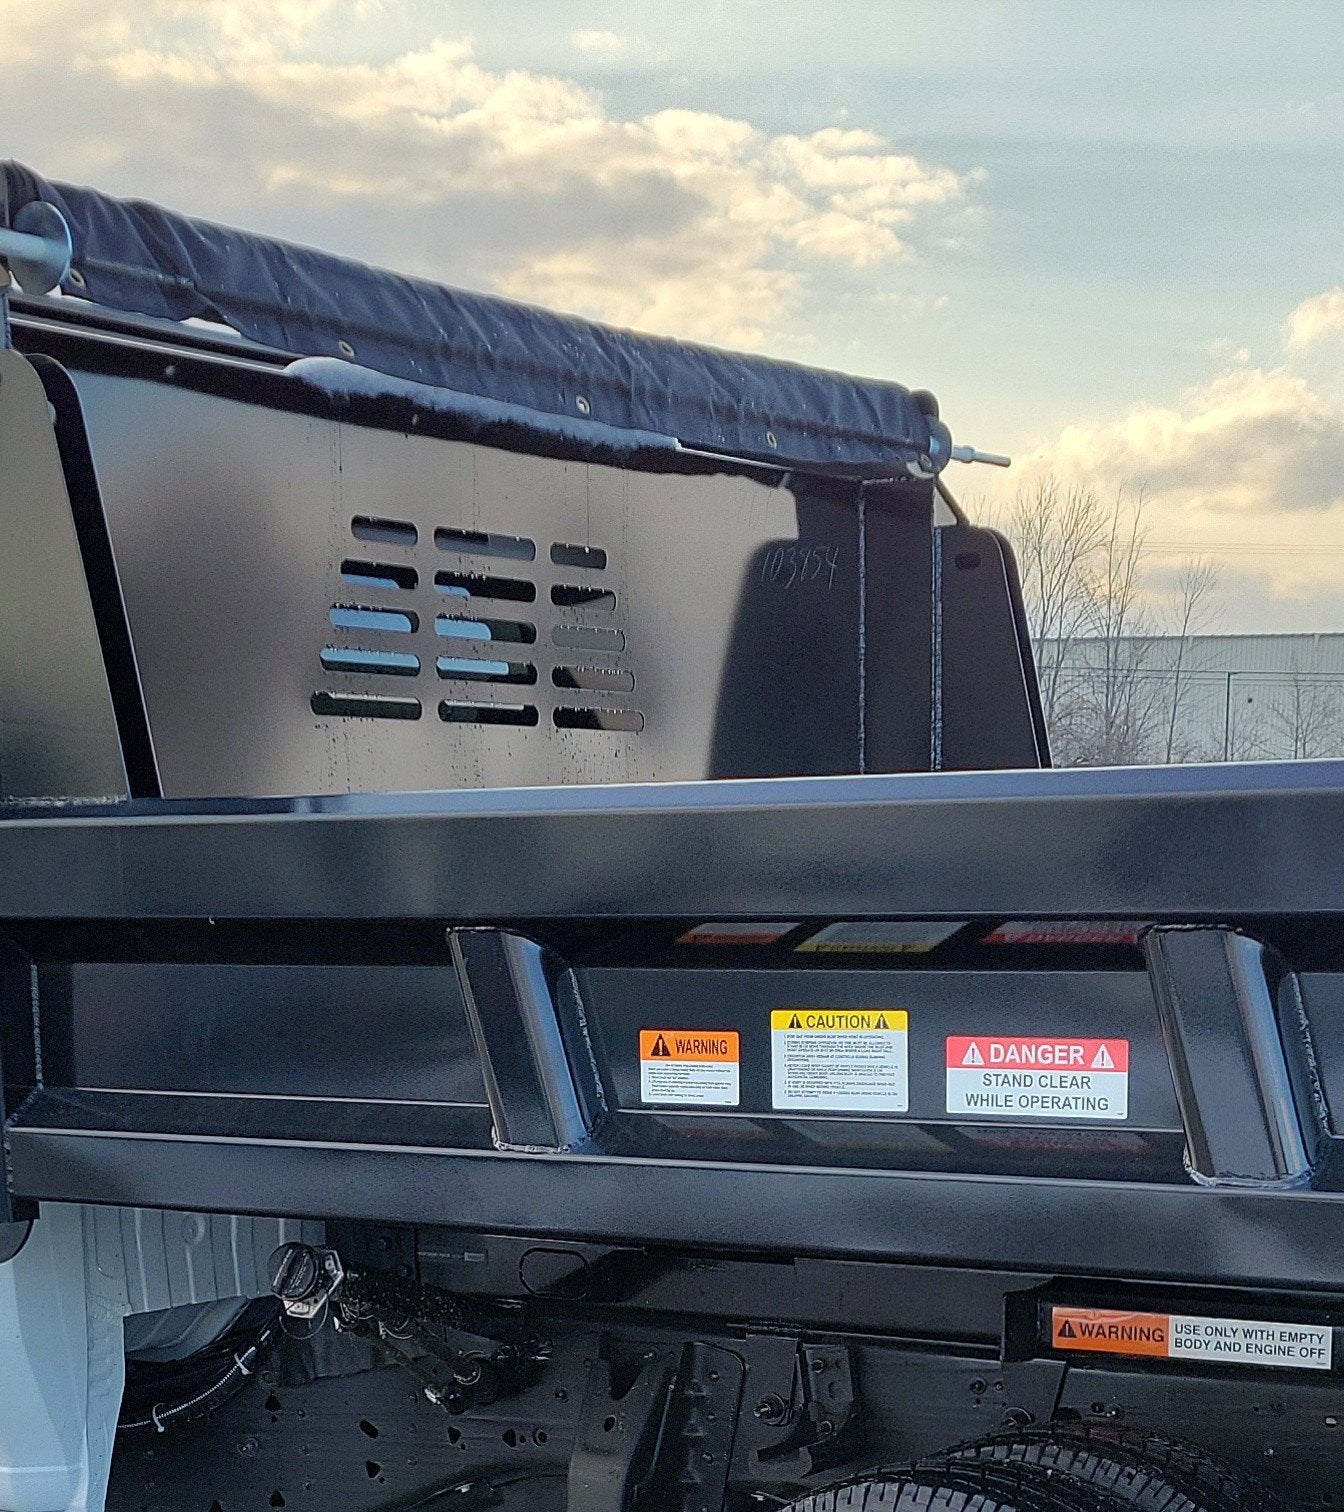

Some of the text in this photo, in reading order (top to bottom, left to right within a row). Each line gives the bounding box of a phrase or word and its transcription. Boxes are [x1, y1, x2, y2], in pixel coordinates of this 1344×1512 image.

[806, 1015, 871, 1028] CAUTION
[675, 1039, 728, 1055] WARNING
[989, 1043, 1085, 1066] DANGER
[982, 1073, 1092, 1089] STAND CLEAR
[965, 1093, 1110, 1111] WHILE OPERATING
[1079, 1322, 1165, 1343] WARNING
[1175, 1323, 1325, 1345] USE ONLY WITH EMPTY
[1174, 1338, 1326, 1359] BODY AND ENGINE OFF
